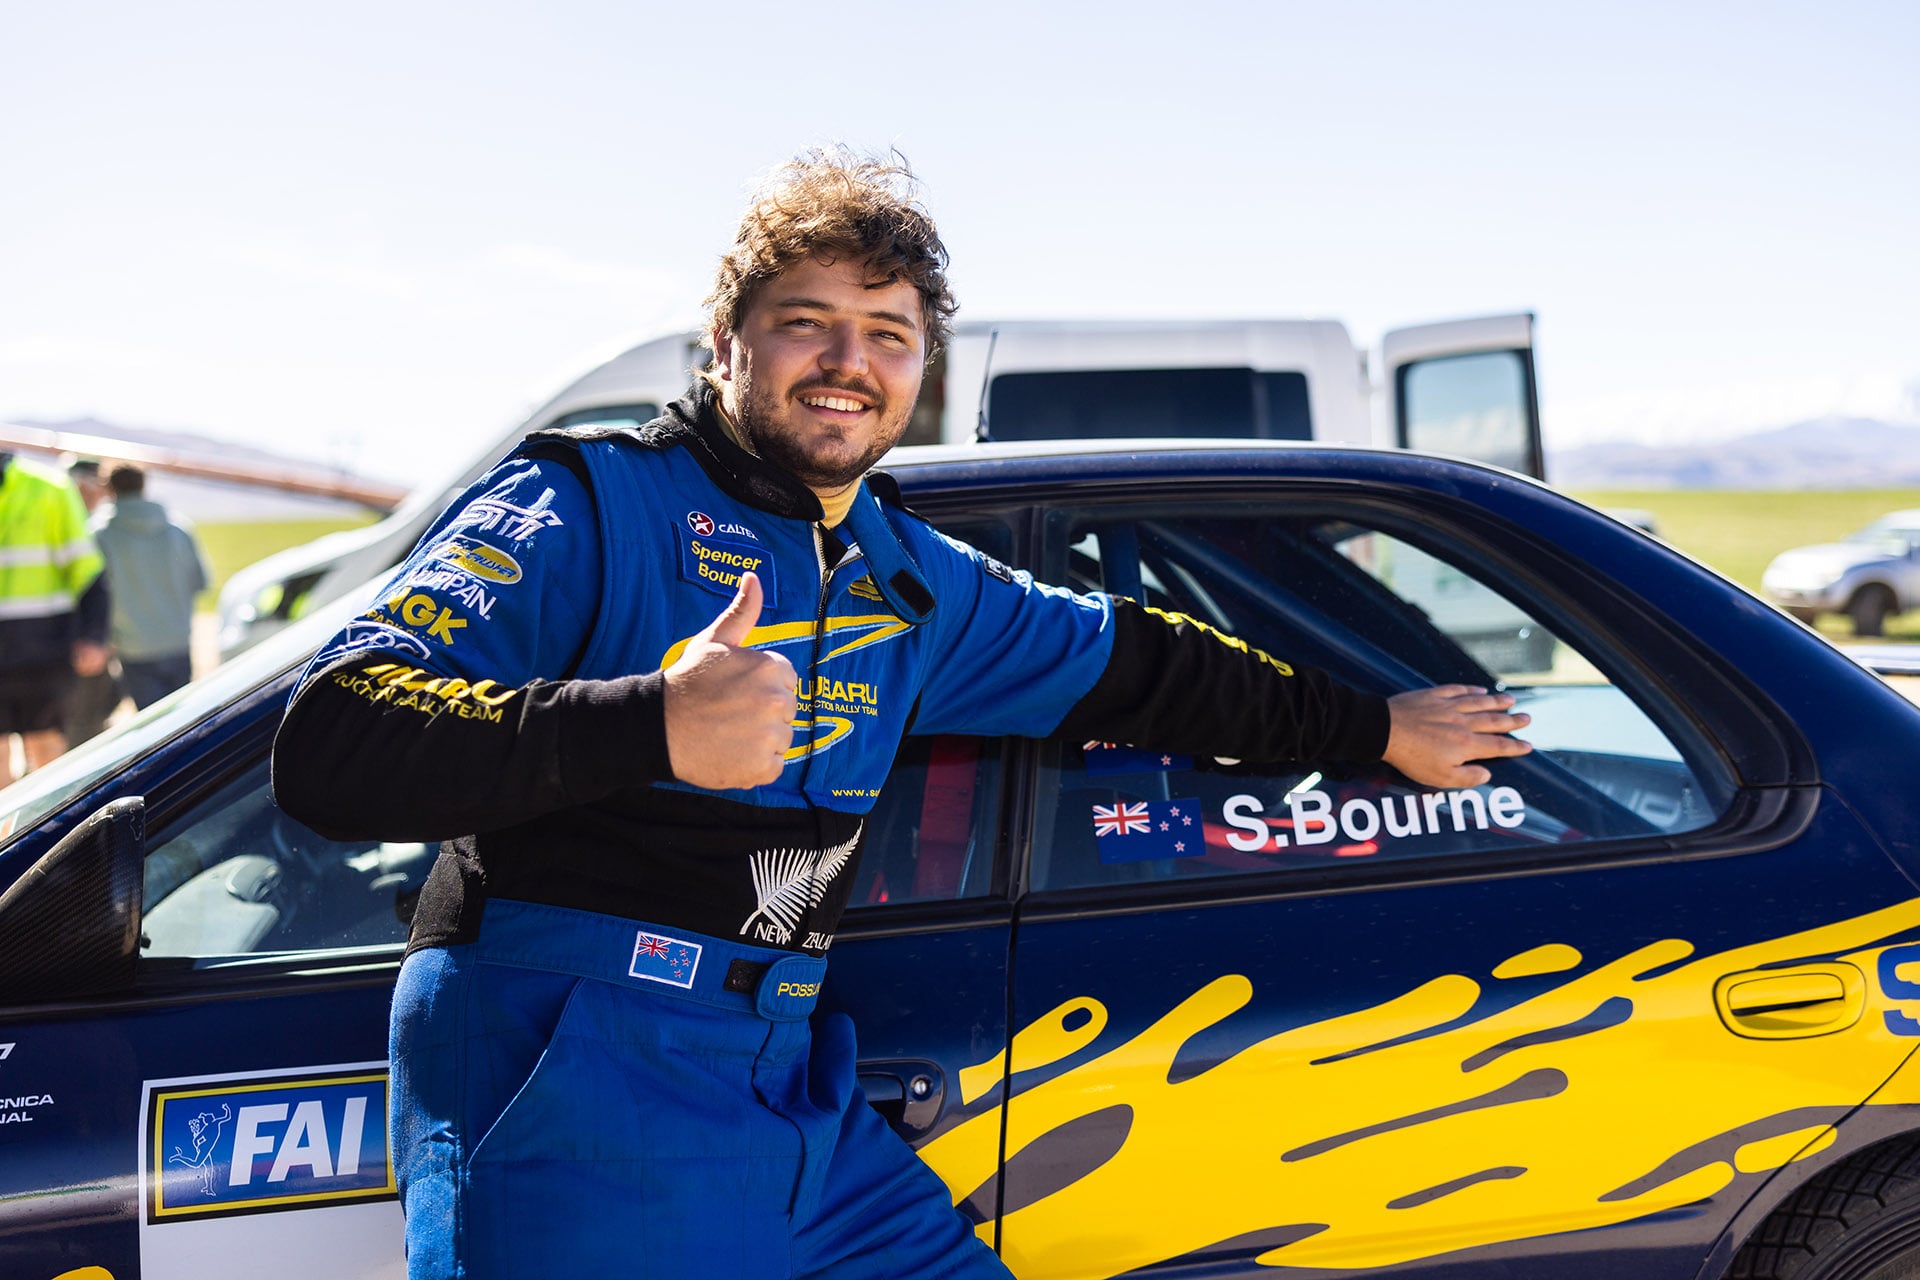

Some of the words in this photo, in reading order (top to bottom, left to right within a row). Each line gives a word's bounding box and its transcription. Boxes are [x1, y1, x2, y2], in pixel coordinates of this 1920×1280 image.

[691, 540, 762, 571] Spencer
[794, 675, 878, 705] UBARU
[447, 698, 503, 724] TEAM
[835, 704, 861, 713] RALLY
[1221, 785, 1526, 852] S.Bourne
[754, 921, 792, 945] NEW
[0, 1094, 54, 1109] NICA
[228, 1096, 368, 1187] FAI
